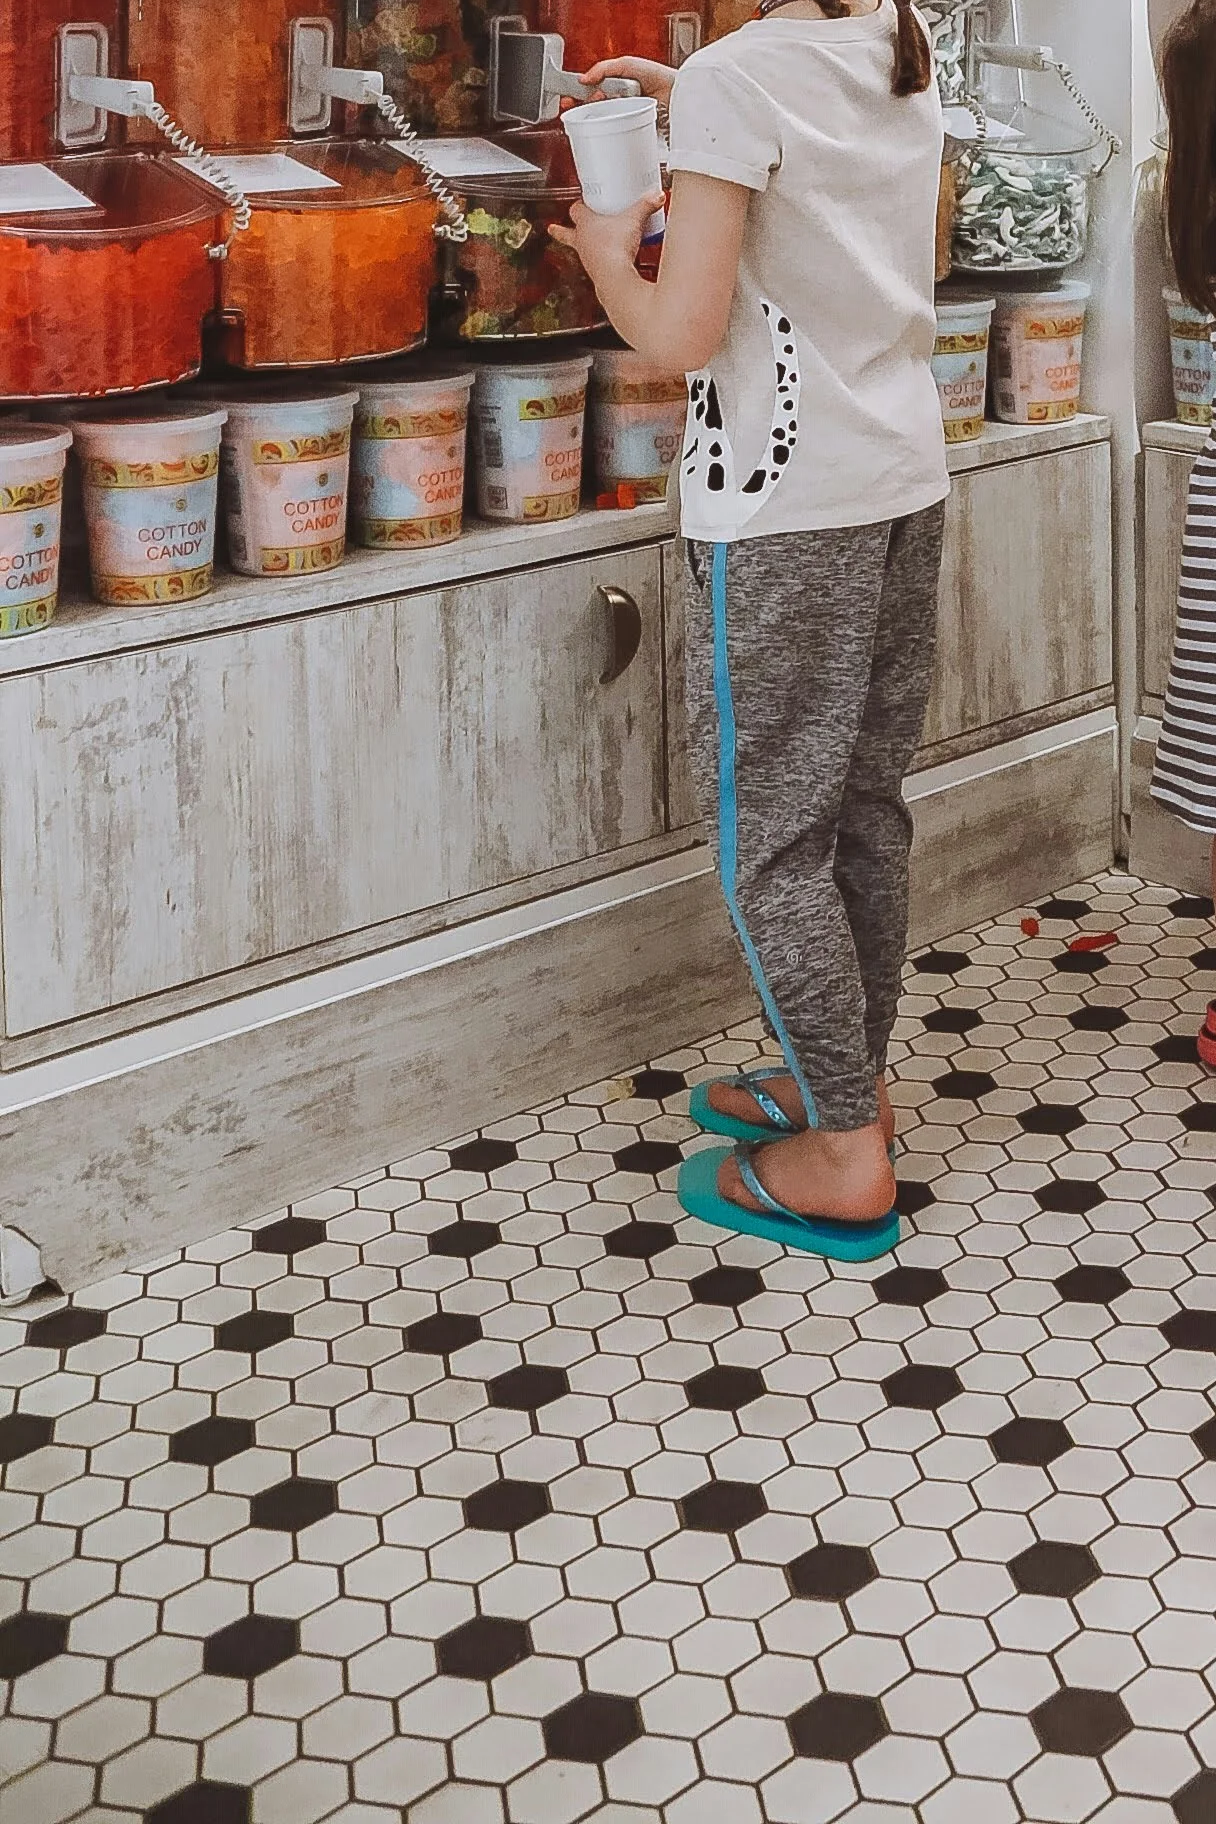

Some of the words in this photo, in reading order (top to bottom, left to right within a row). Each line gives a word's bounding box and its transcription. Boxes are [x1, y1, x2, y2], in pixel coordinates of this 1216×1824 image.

[418, 467, 463, 487] COTTO
[138, 519, 207, 543] COTTON
[146, 539, 202, 561] CANDY
